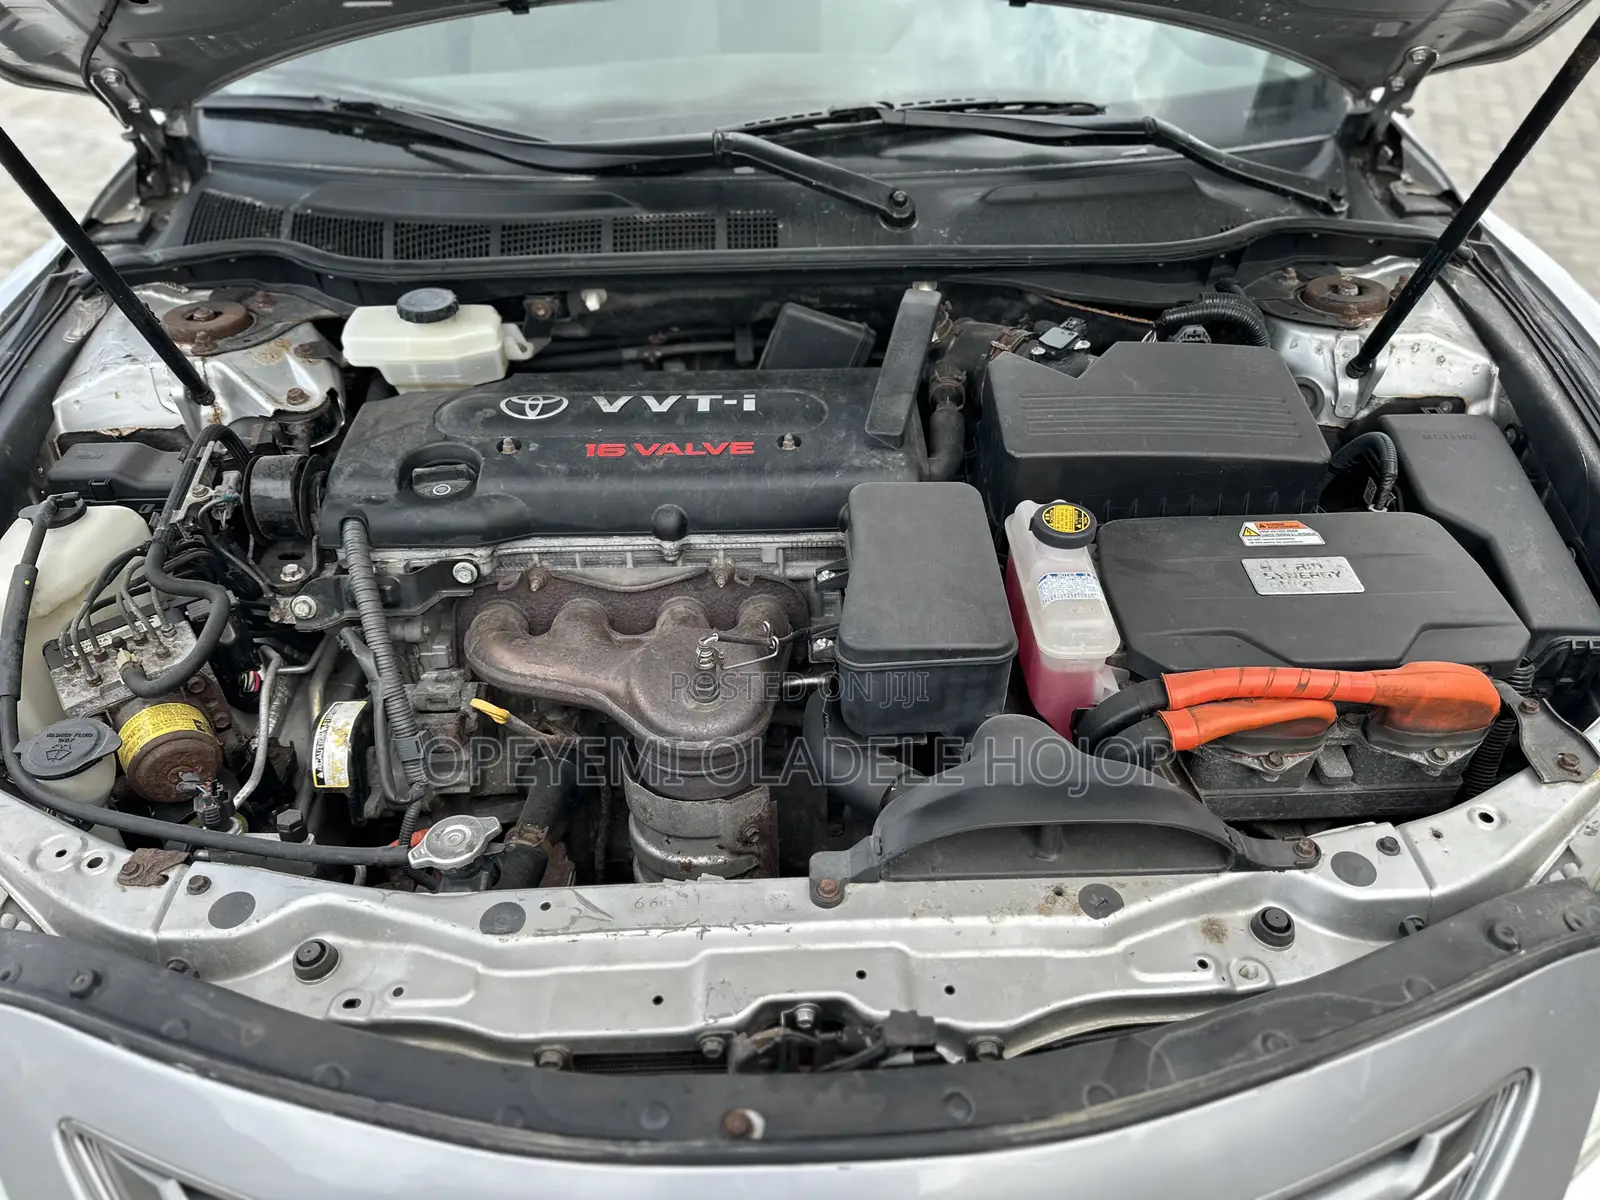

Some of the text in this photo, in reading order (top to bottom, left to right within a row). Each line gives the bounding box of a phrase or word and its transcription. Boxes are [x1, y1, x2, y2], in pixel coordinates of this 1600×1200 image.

[592, 394, 756, 413] VVT-i
[585, 441, 754, 457] 16 VALVE
